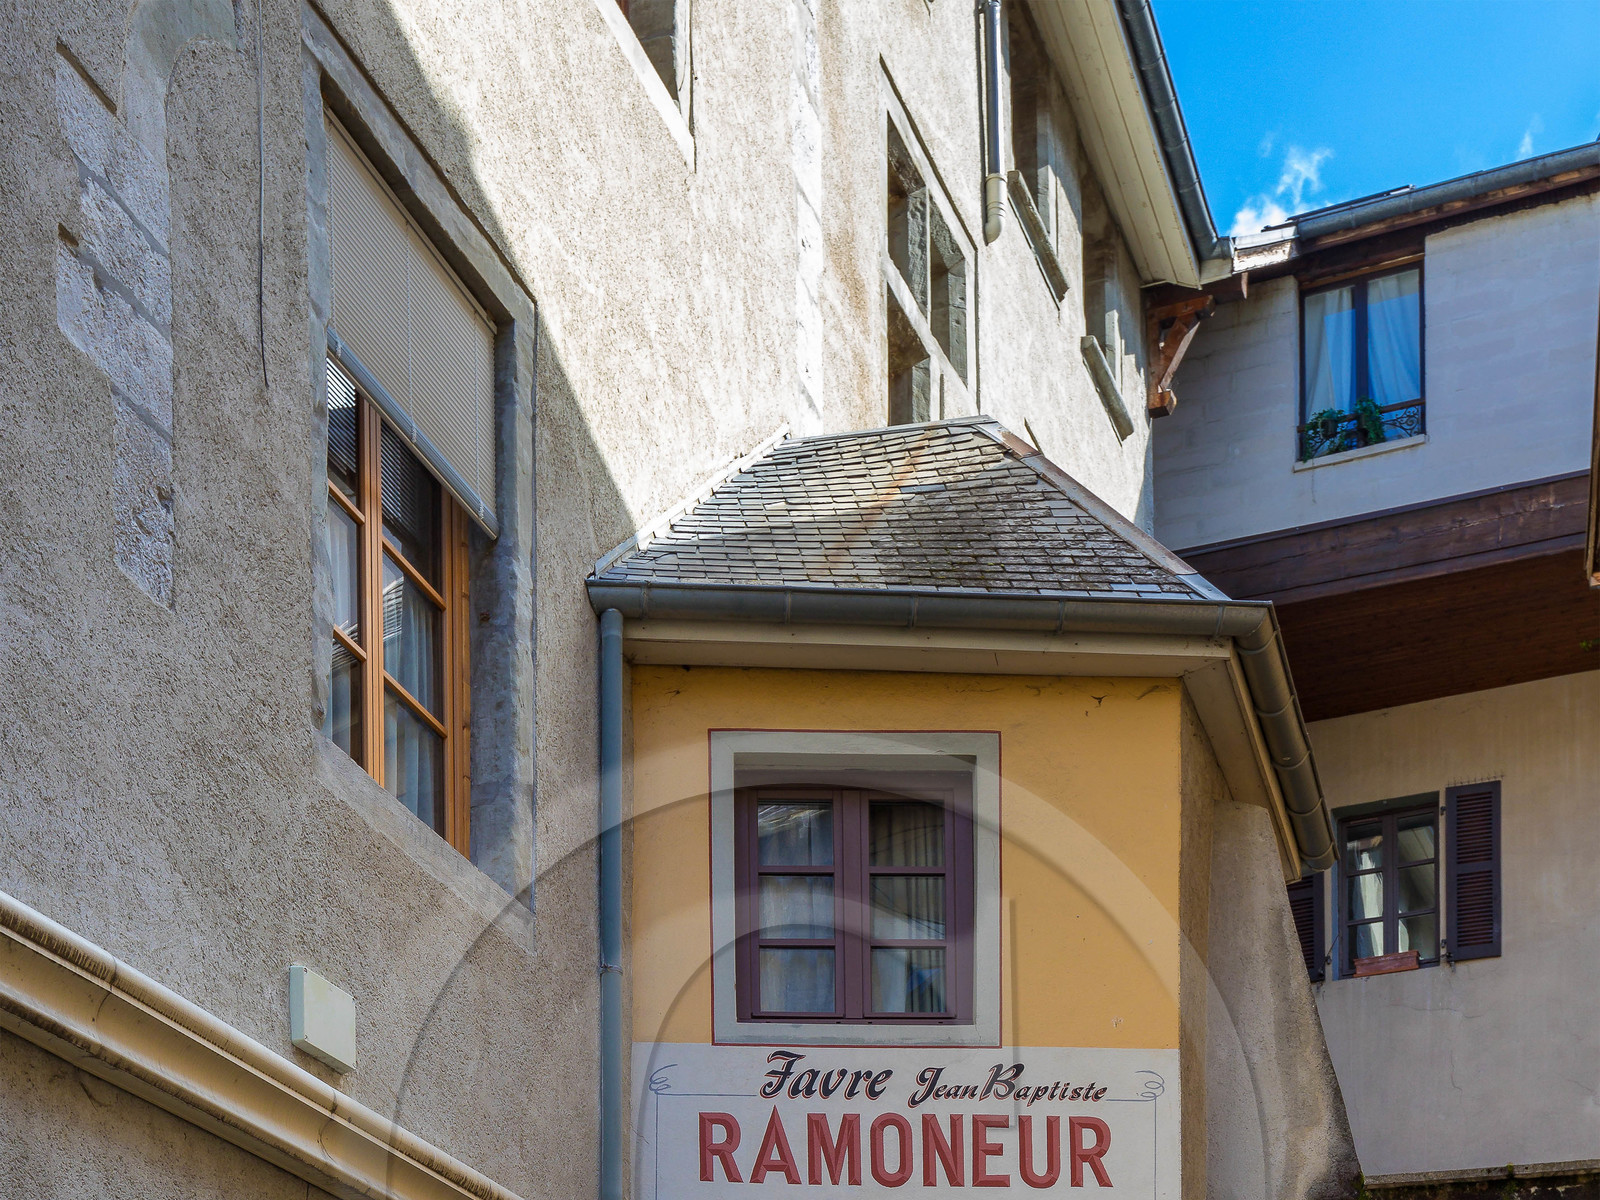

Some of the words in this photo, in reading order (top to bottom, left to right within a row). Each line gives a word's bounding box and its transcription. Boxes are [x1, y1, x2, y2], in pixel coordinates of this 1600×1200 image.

[759, 1050, 894, 1101] Favre
[907, 1066, 980, 1109] Jean
[980, 1063, 1109, 1106] Baptiste
[699, 1105, 1115, 1189] RAMONEUR
